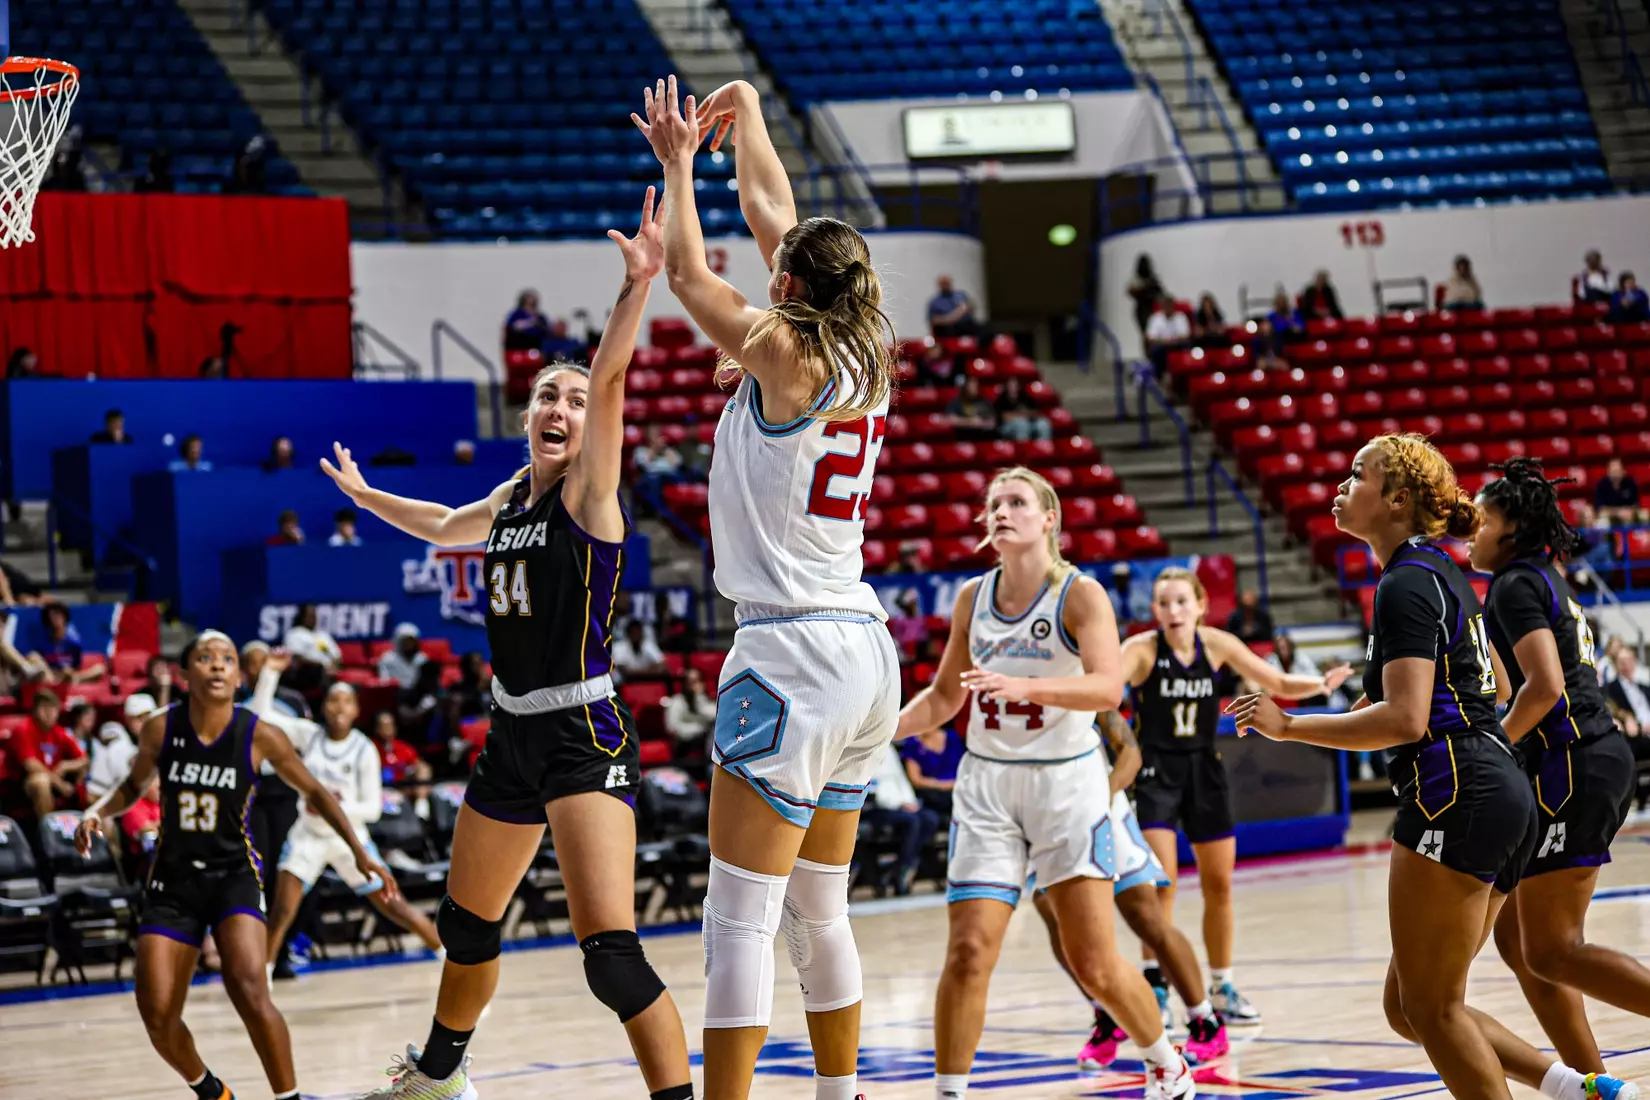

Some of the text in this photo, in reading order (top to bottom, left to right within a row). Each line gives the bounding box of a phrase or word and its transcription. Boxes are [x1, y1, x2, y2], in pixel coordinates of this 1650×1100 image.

[1337, 221, 1385, 249] 113
[486, 521, 548, 554] LSUA
[490, 560, 532, 616] 34
[258, 602, 389, 641] STDENT
[1160, 677, 1213, 698] LSUA
[1172, 701, 1198, 737] 11
[168, 760, 237, 790] LSUA
[178, 791, 218, 833] 23
